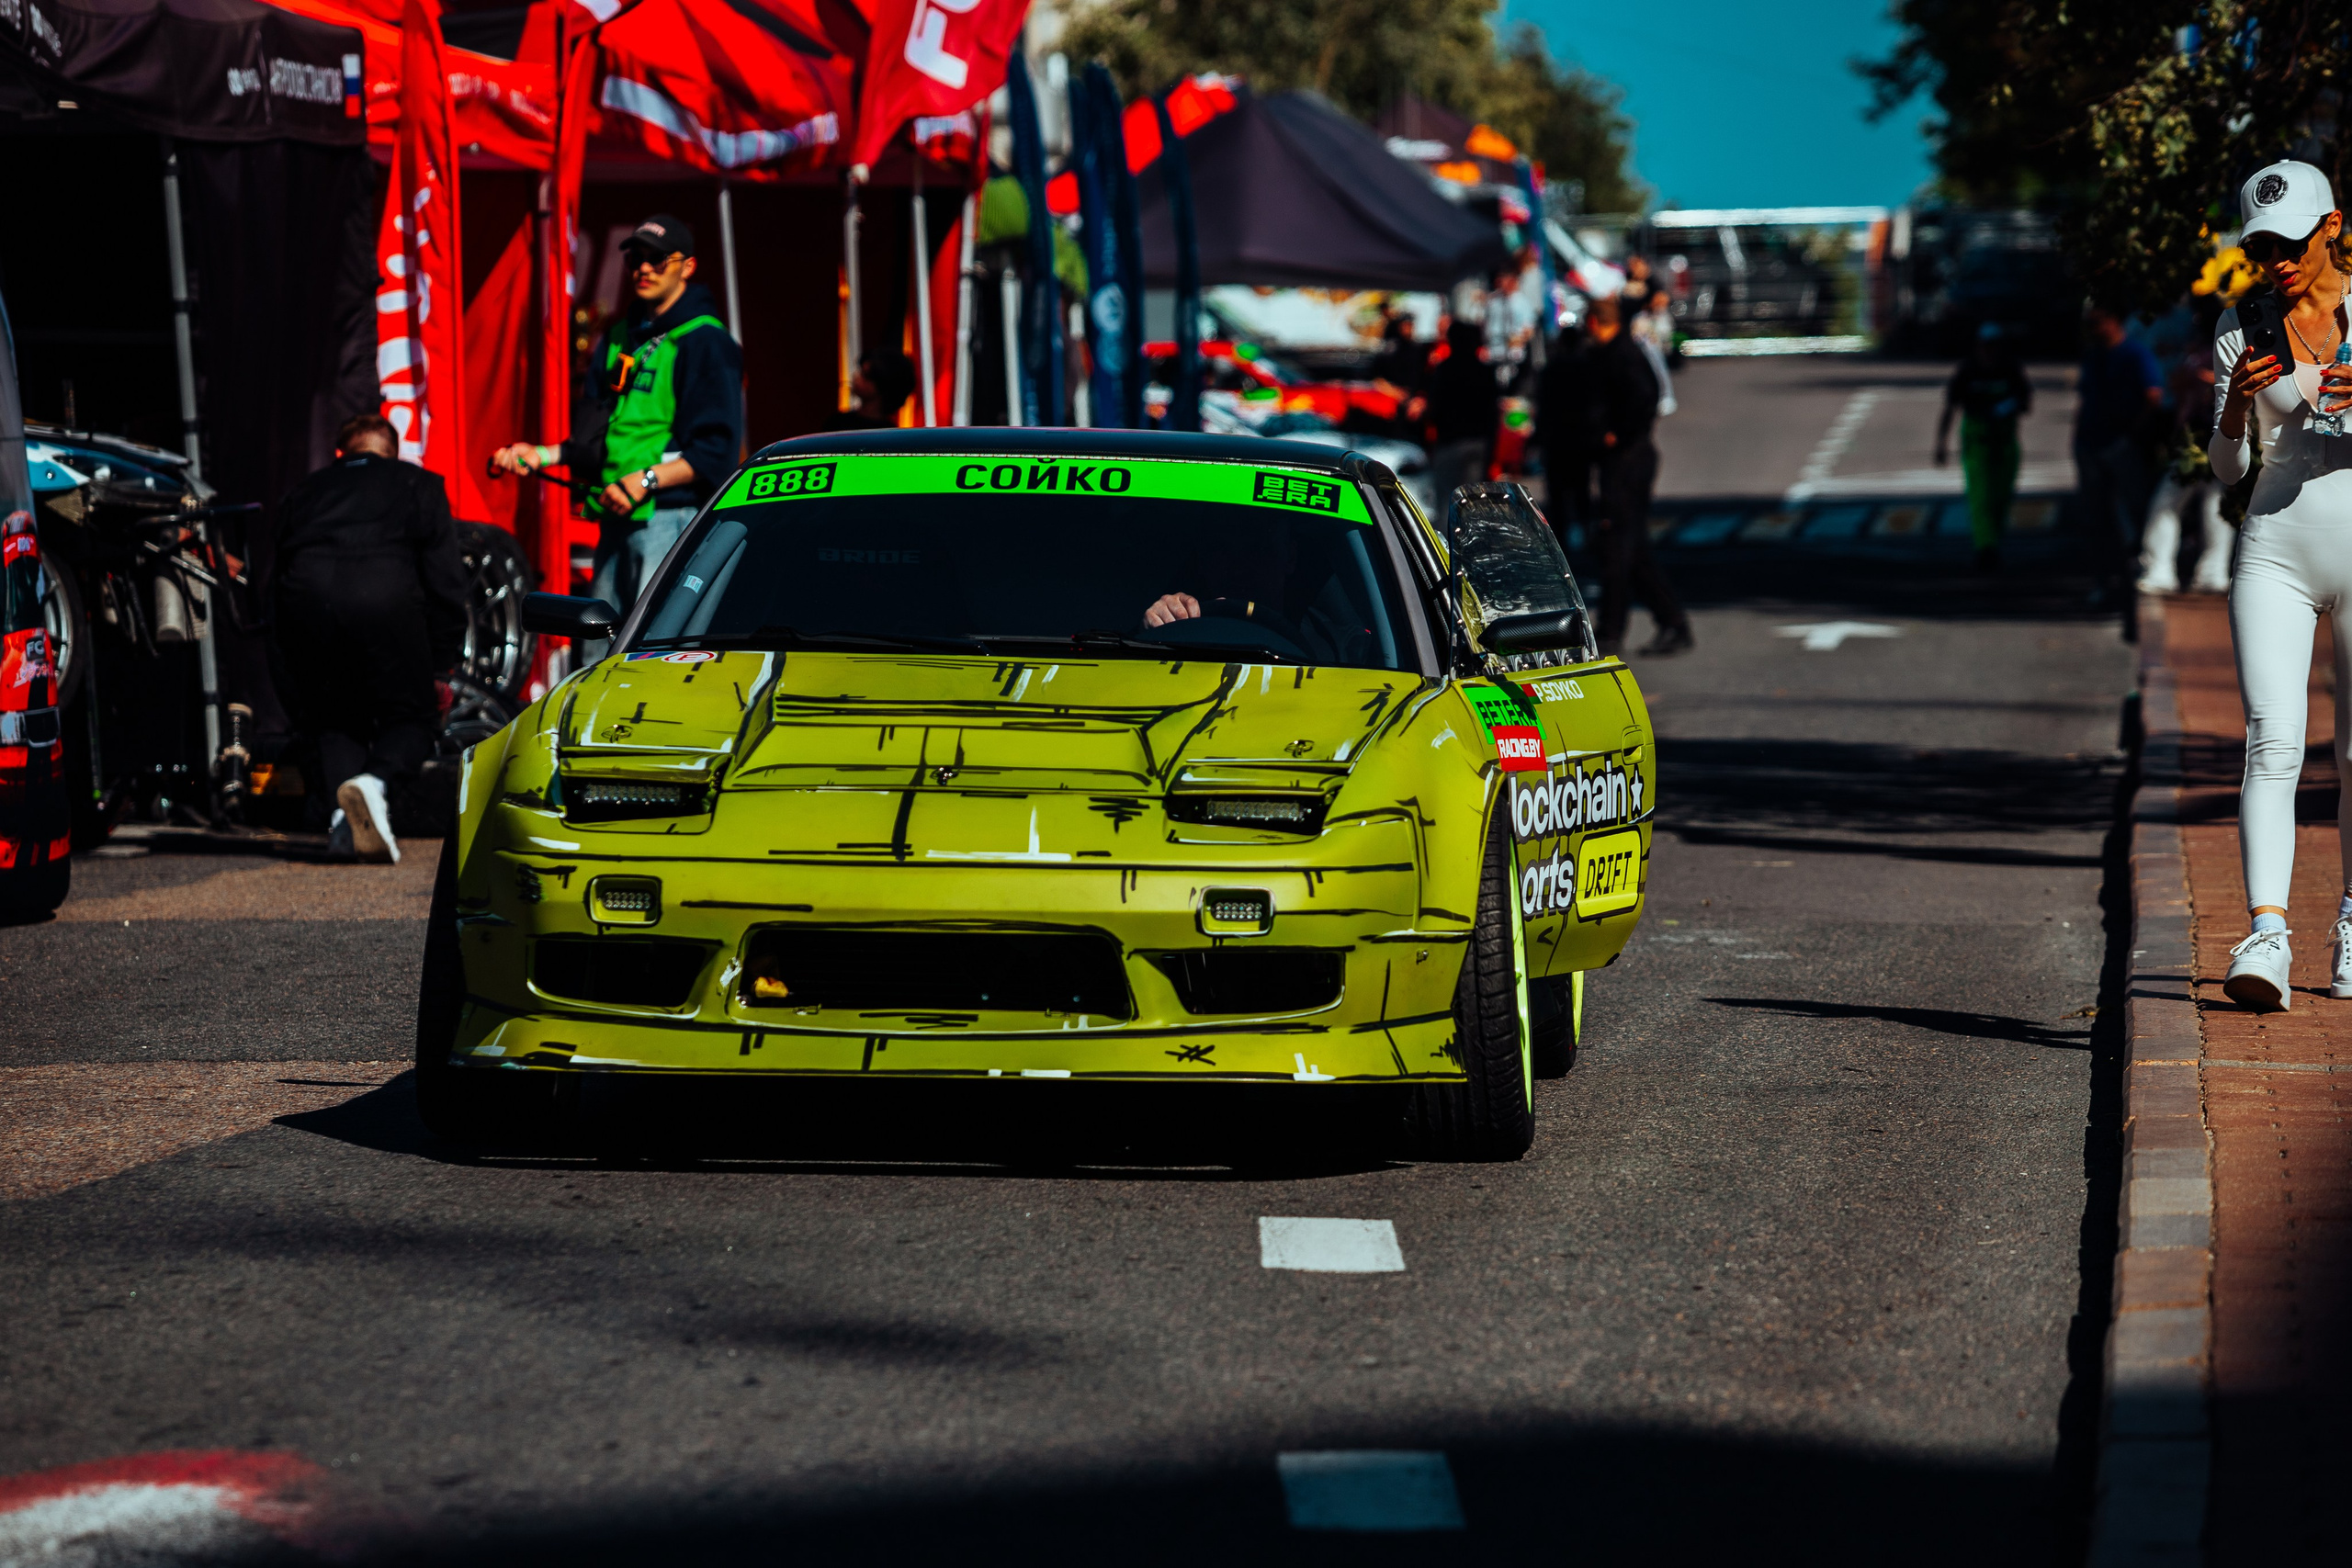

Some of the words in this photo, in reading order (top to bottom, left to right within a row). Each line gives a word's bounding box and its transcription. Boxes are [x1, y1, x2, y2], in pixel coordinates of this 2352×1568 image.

[752, 467, 831, 496] 888
[956, 457, 1131, 492] СОЙКО
[1263, 476, 1332, 495] BET
[817, 547, 922, 564] BRIDE
[1531, 679, 1585, 703] P.SOYKO
[1510, 760, 1627, 837] lockchain
[1521, 847, 1575, 914] orts
[1584, 850, 1634, 899] DRIFT
